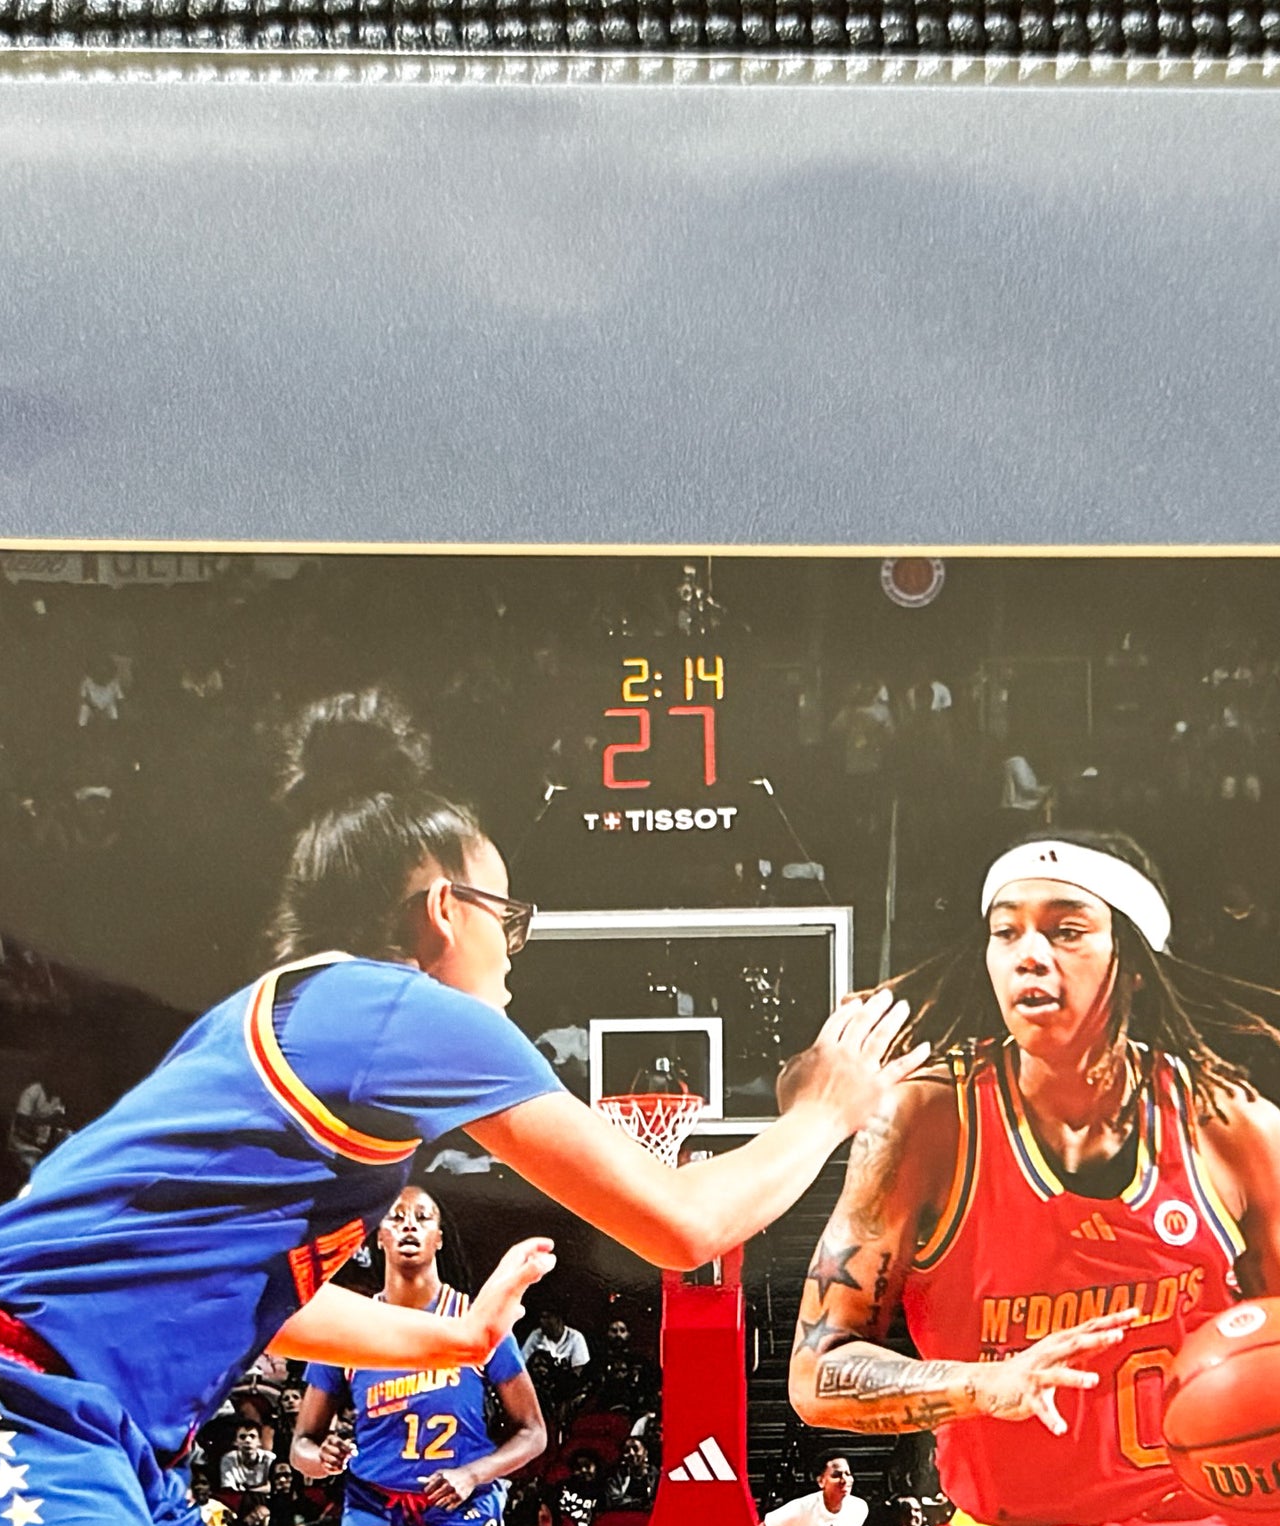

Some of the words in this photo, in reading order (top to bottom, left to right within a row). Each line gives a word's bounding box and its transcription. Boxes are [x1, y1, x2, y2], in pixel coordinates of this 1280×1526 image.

[622, 656, 724, 702] 2:14
[603, 706, 717, 789] 27
[625, 806, 738, 832] TISSOT
[401, 1413, 458, 1461] 12
